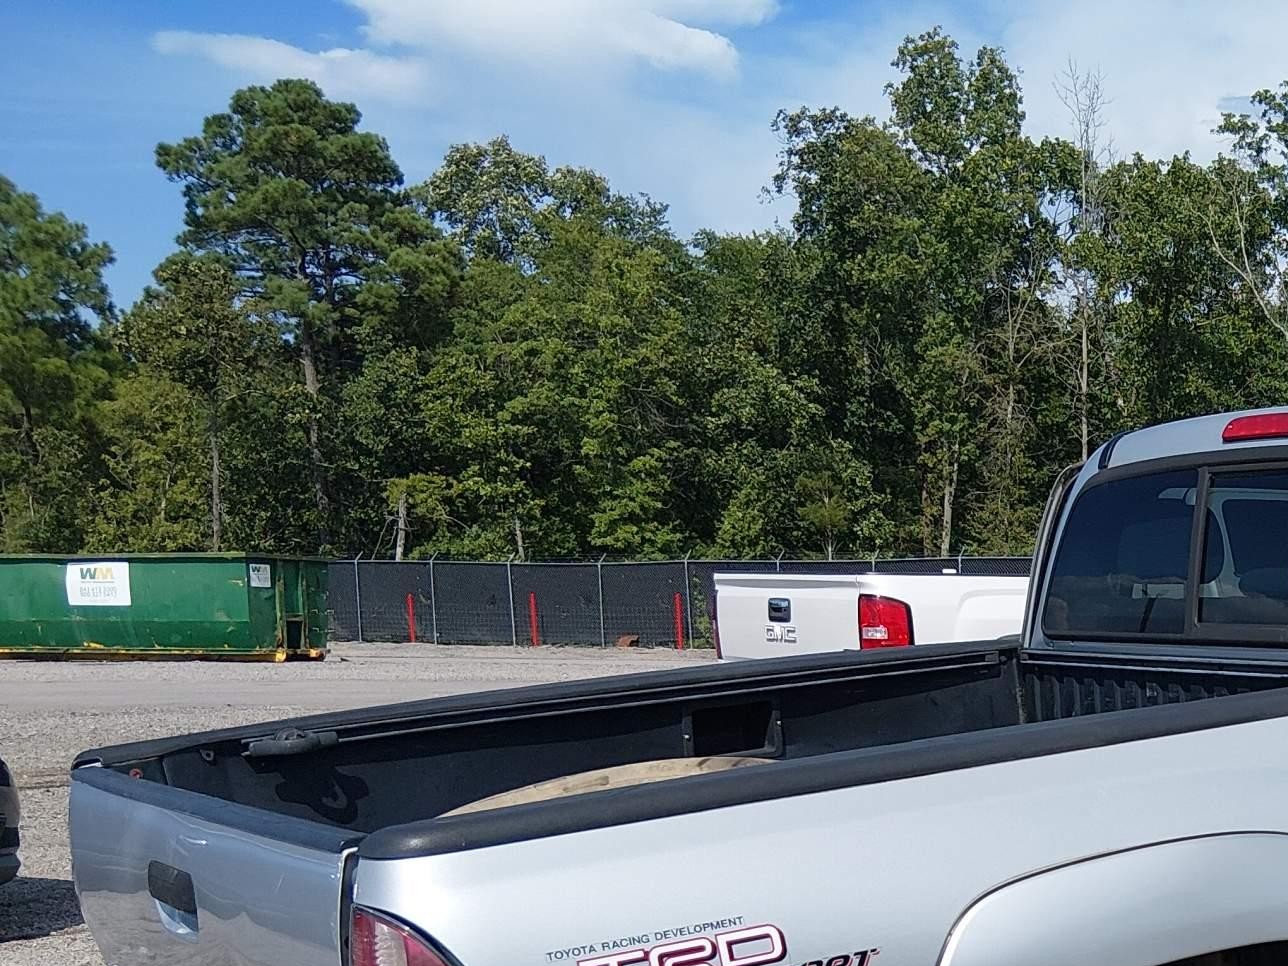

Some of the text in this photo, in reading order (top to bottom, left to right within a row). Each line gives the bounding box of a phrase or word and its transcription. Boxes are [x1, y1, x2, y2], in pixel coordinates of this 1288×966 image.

[80, 568, 113, 580] WM
[765, 625, 797, 643] GMC
[546, 916, 744, 962] TOYOTA RACING DEVELOPMENT
